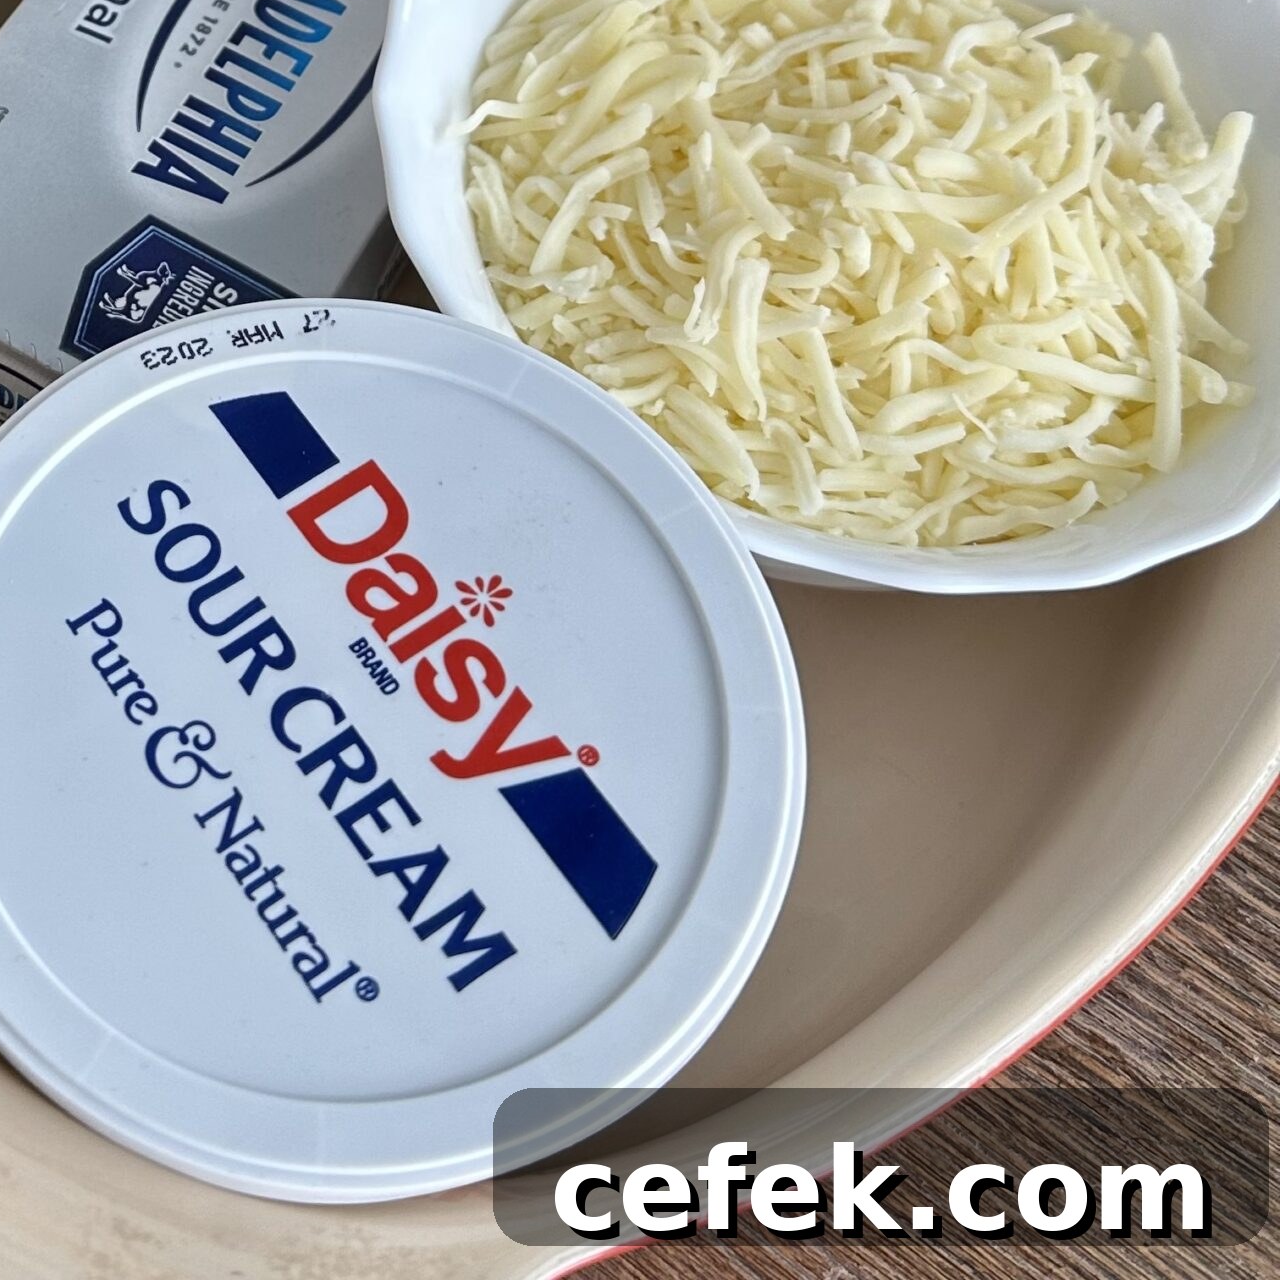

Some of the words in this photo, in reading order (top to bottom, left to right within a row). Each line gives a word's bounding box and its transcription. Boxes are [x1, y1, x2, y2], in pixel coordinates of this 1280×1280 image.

[179, 15, 219, 57] 1872
[204, 281, 239, 312] SI
[140, 337, 214, 370] 2023
[285, 458, 572, 781] Daisy
[66, 597, 158, 726] Pure
[144, 719, 232, 790] &
[348, 636, 400, 697] BRAND
[117, 479, 297, 697] SOUR
[269, 685, 518, 993] CREAM
